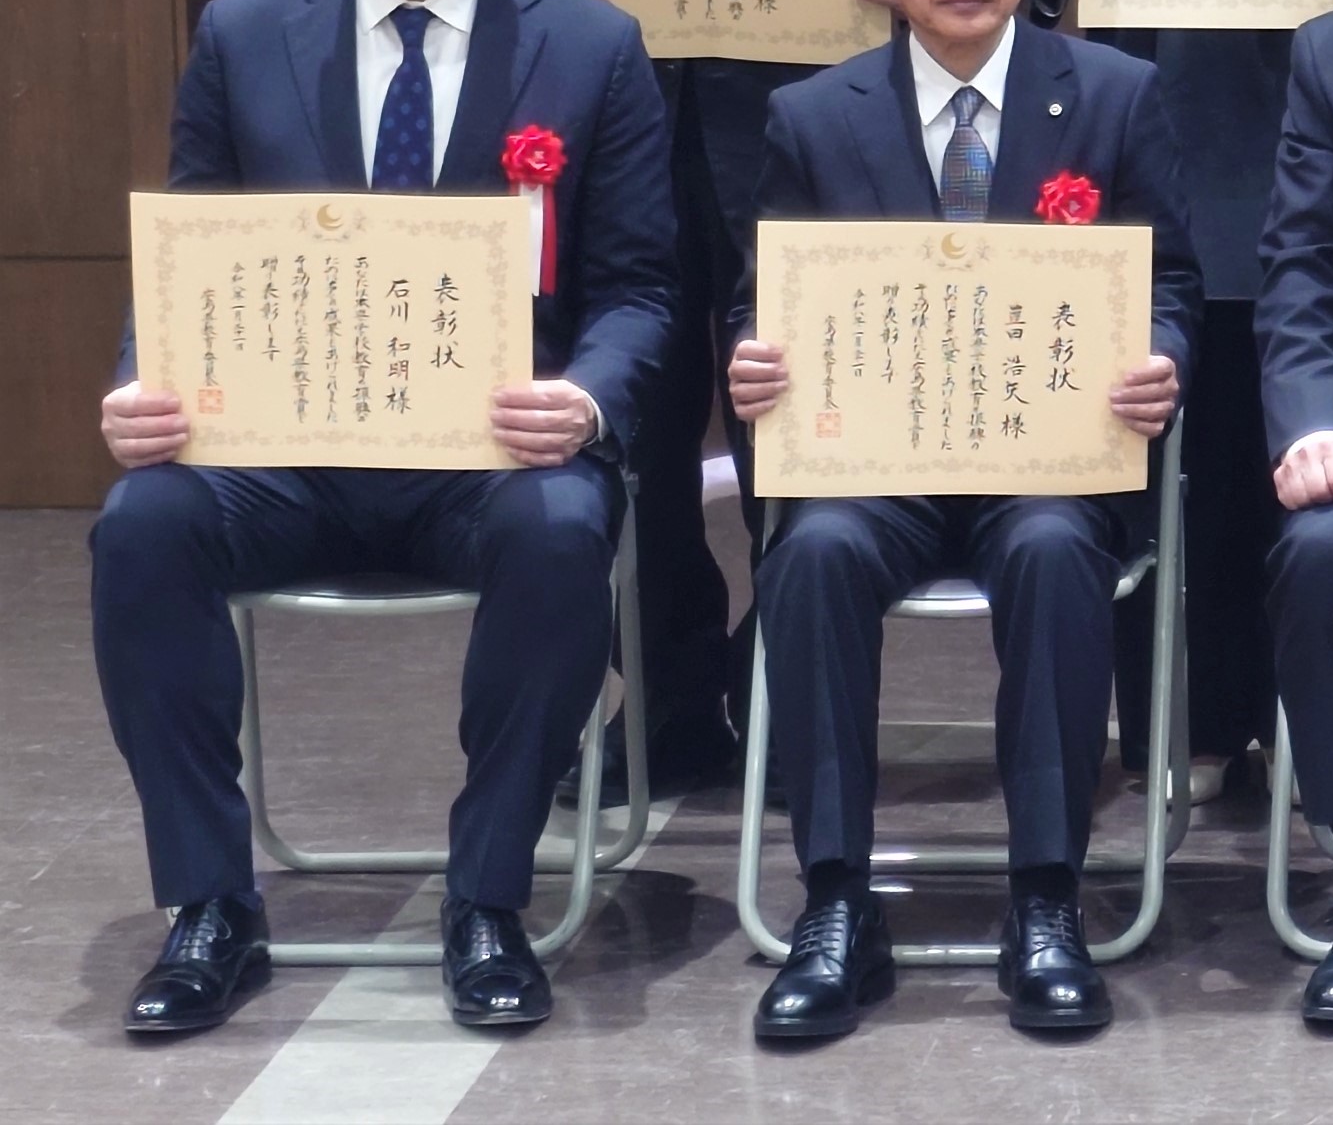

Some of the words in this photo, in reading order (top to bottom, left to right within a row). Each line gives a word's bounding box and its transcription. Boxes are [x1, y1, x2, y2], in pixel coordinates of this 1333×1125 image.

[384, 278, 412, 415] 石川和明様
[429, 272, 465, 369] 表彰状
[1045, 300, 1082, 393] 表彰状
